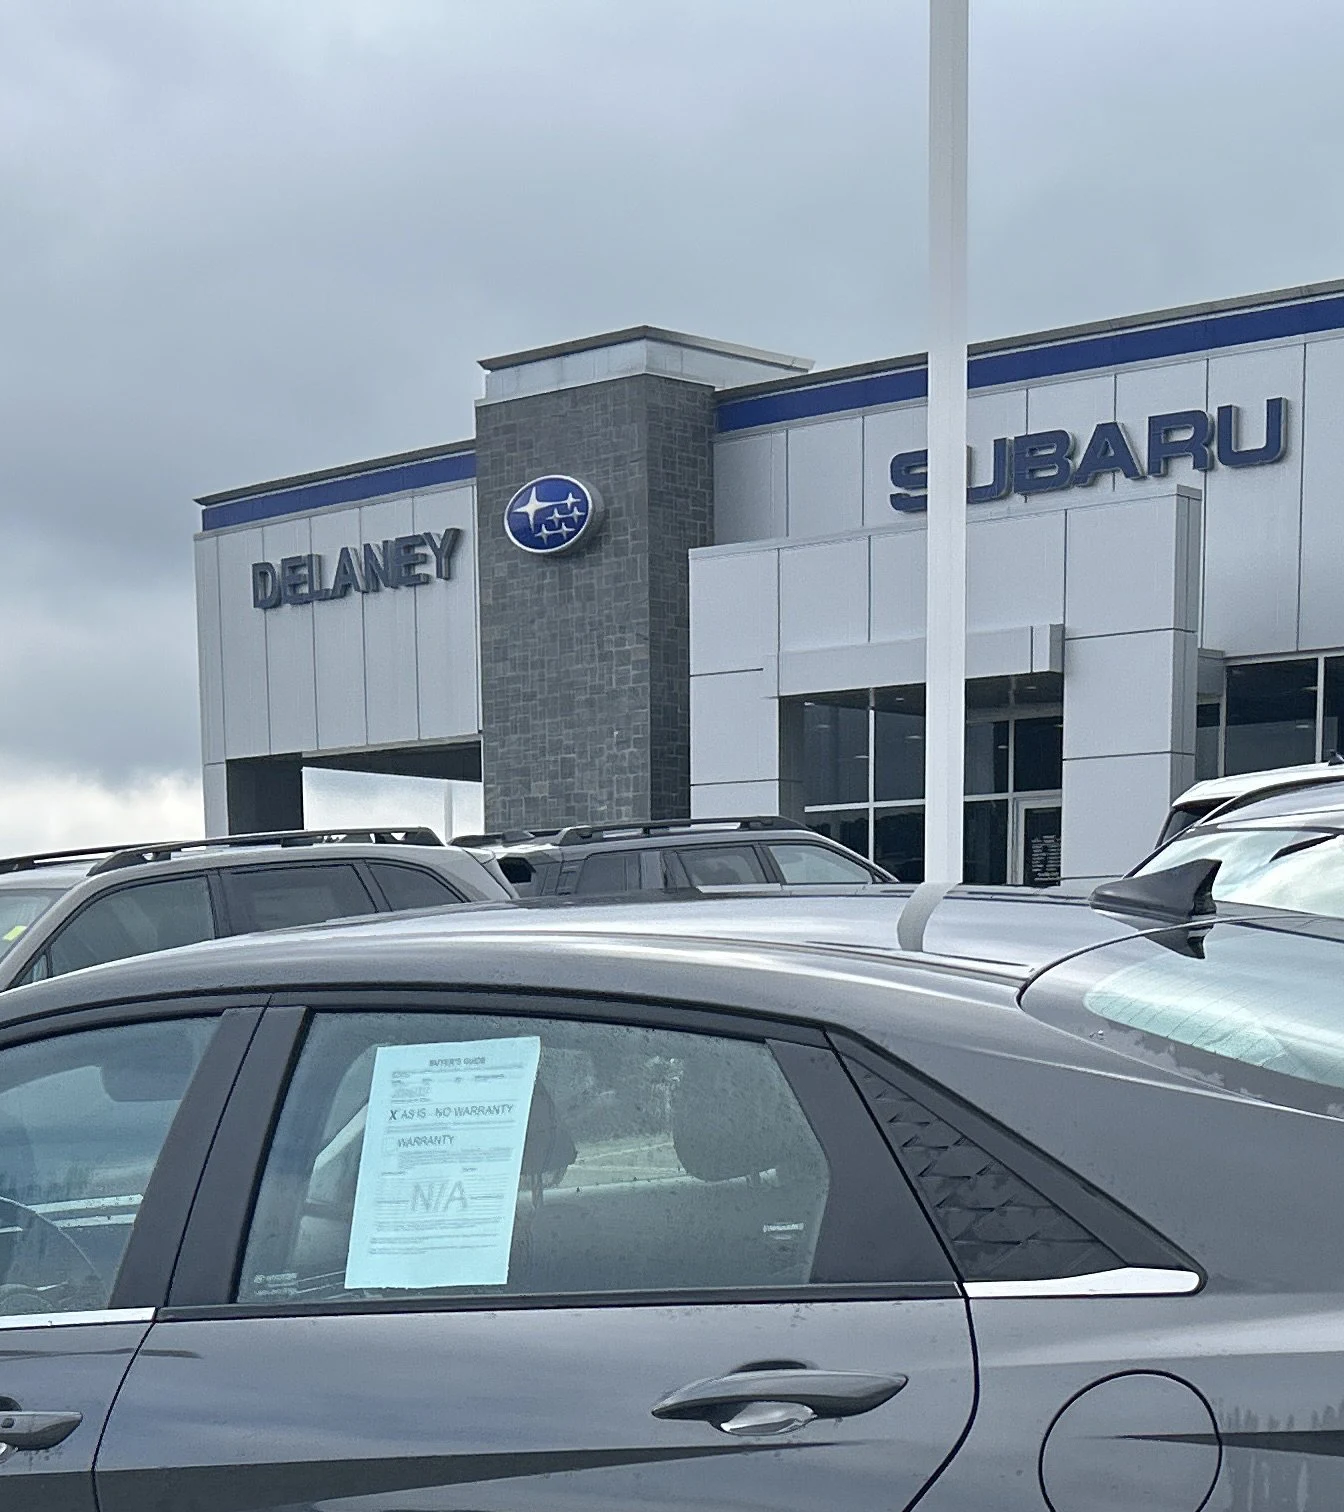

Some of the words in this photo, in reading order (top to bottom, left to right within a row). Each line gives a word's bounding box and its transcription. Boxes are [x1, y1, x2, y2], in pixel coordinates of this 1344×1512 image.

[889, 397, 1288, 513] SUBARU
[251, 527, 463, 609] DELANEY
[401, 1109, 414, 1120] AS
[416, 1108, 426, 1118] IS
[435, 1106, 452, 1118] NO
[453, 1104, 514, 1117] WARRANTY
[397, 1134, 454, 1148] WARRANTY
[411, 1180, 468, 1213] N/A
